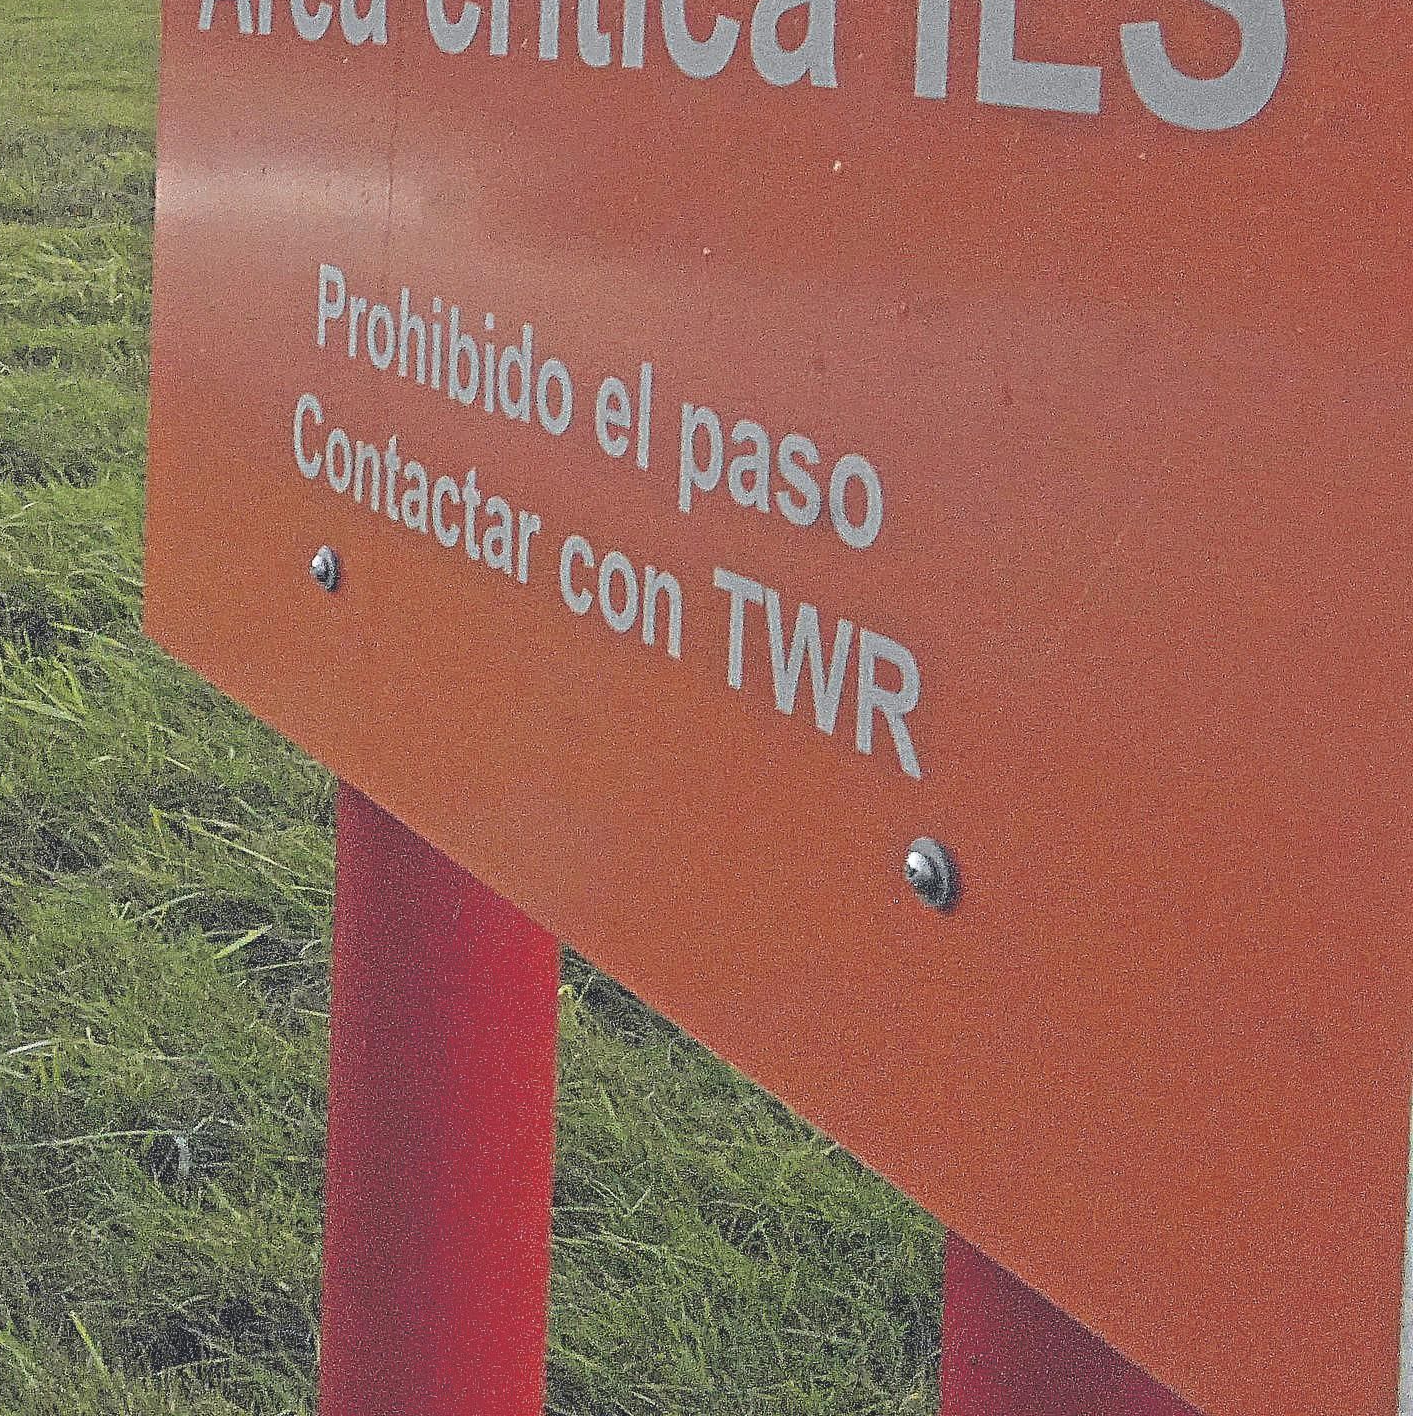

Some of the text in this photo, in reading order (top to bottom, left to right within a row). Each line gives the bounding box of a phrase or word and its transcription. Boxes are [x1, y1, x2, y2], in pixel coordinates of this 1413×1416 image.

[316, 264, 884, 550] Prohibido el paso
[292, 393, 922, 779] Contactar con TWR
